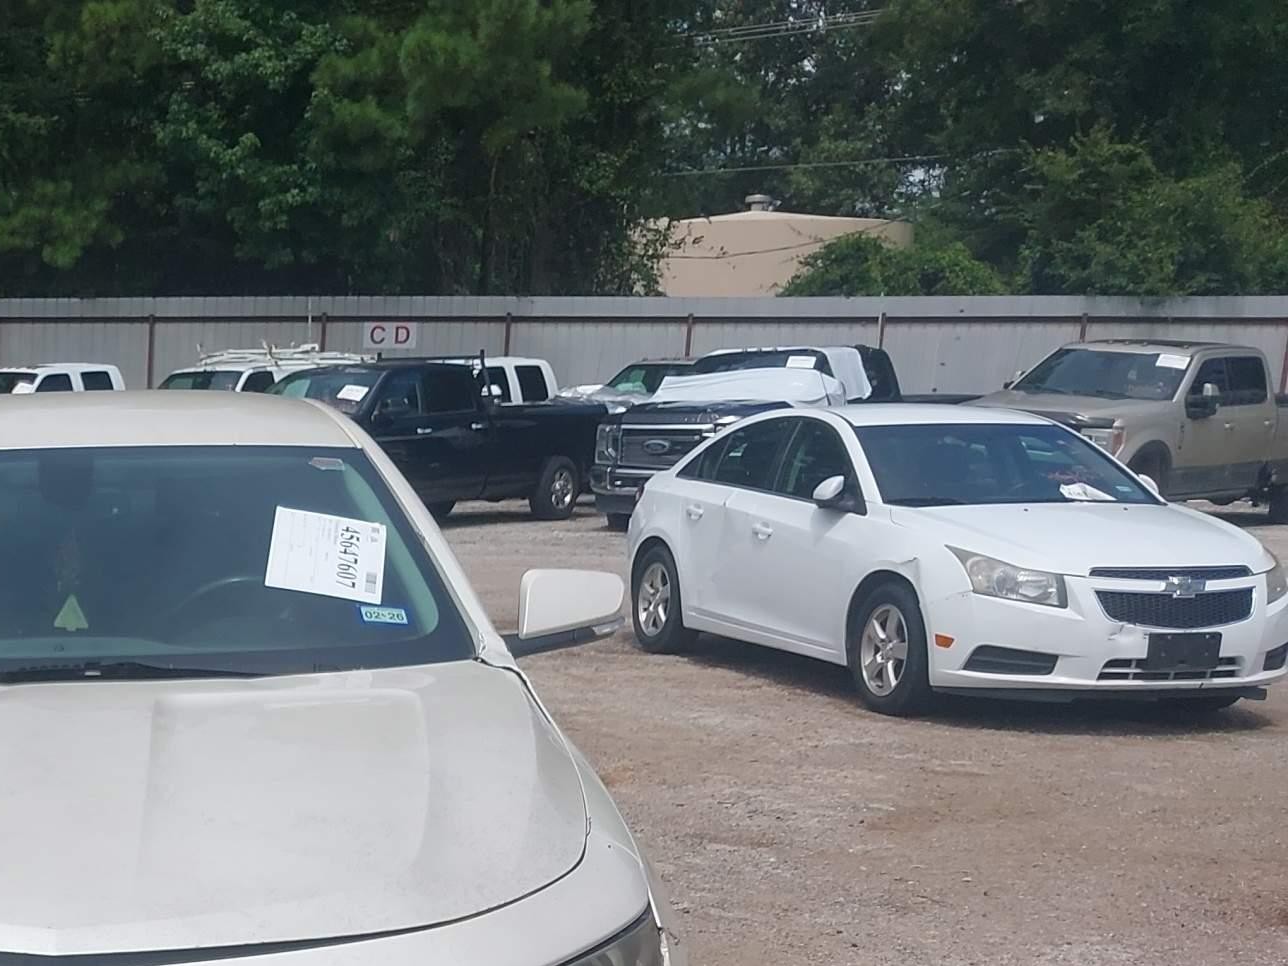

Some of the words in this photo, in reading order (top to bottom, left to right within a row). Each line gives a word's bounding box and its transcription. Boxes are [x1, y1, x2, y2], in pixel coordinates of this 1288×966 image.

[370, 325, 386, 345] C
[394, 325, 410, 345] D
[336, 526, 361, 589] 45647607
